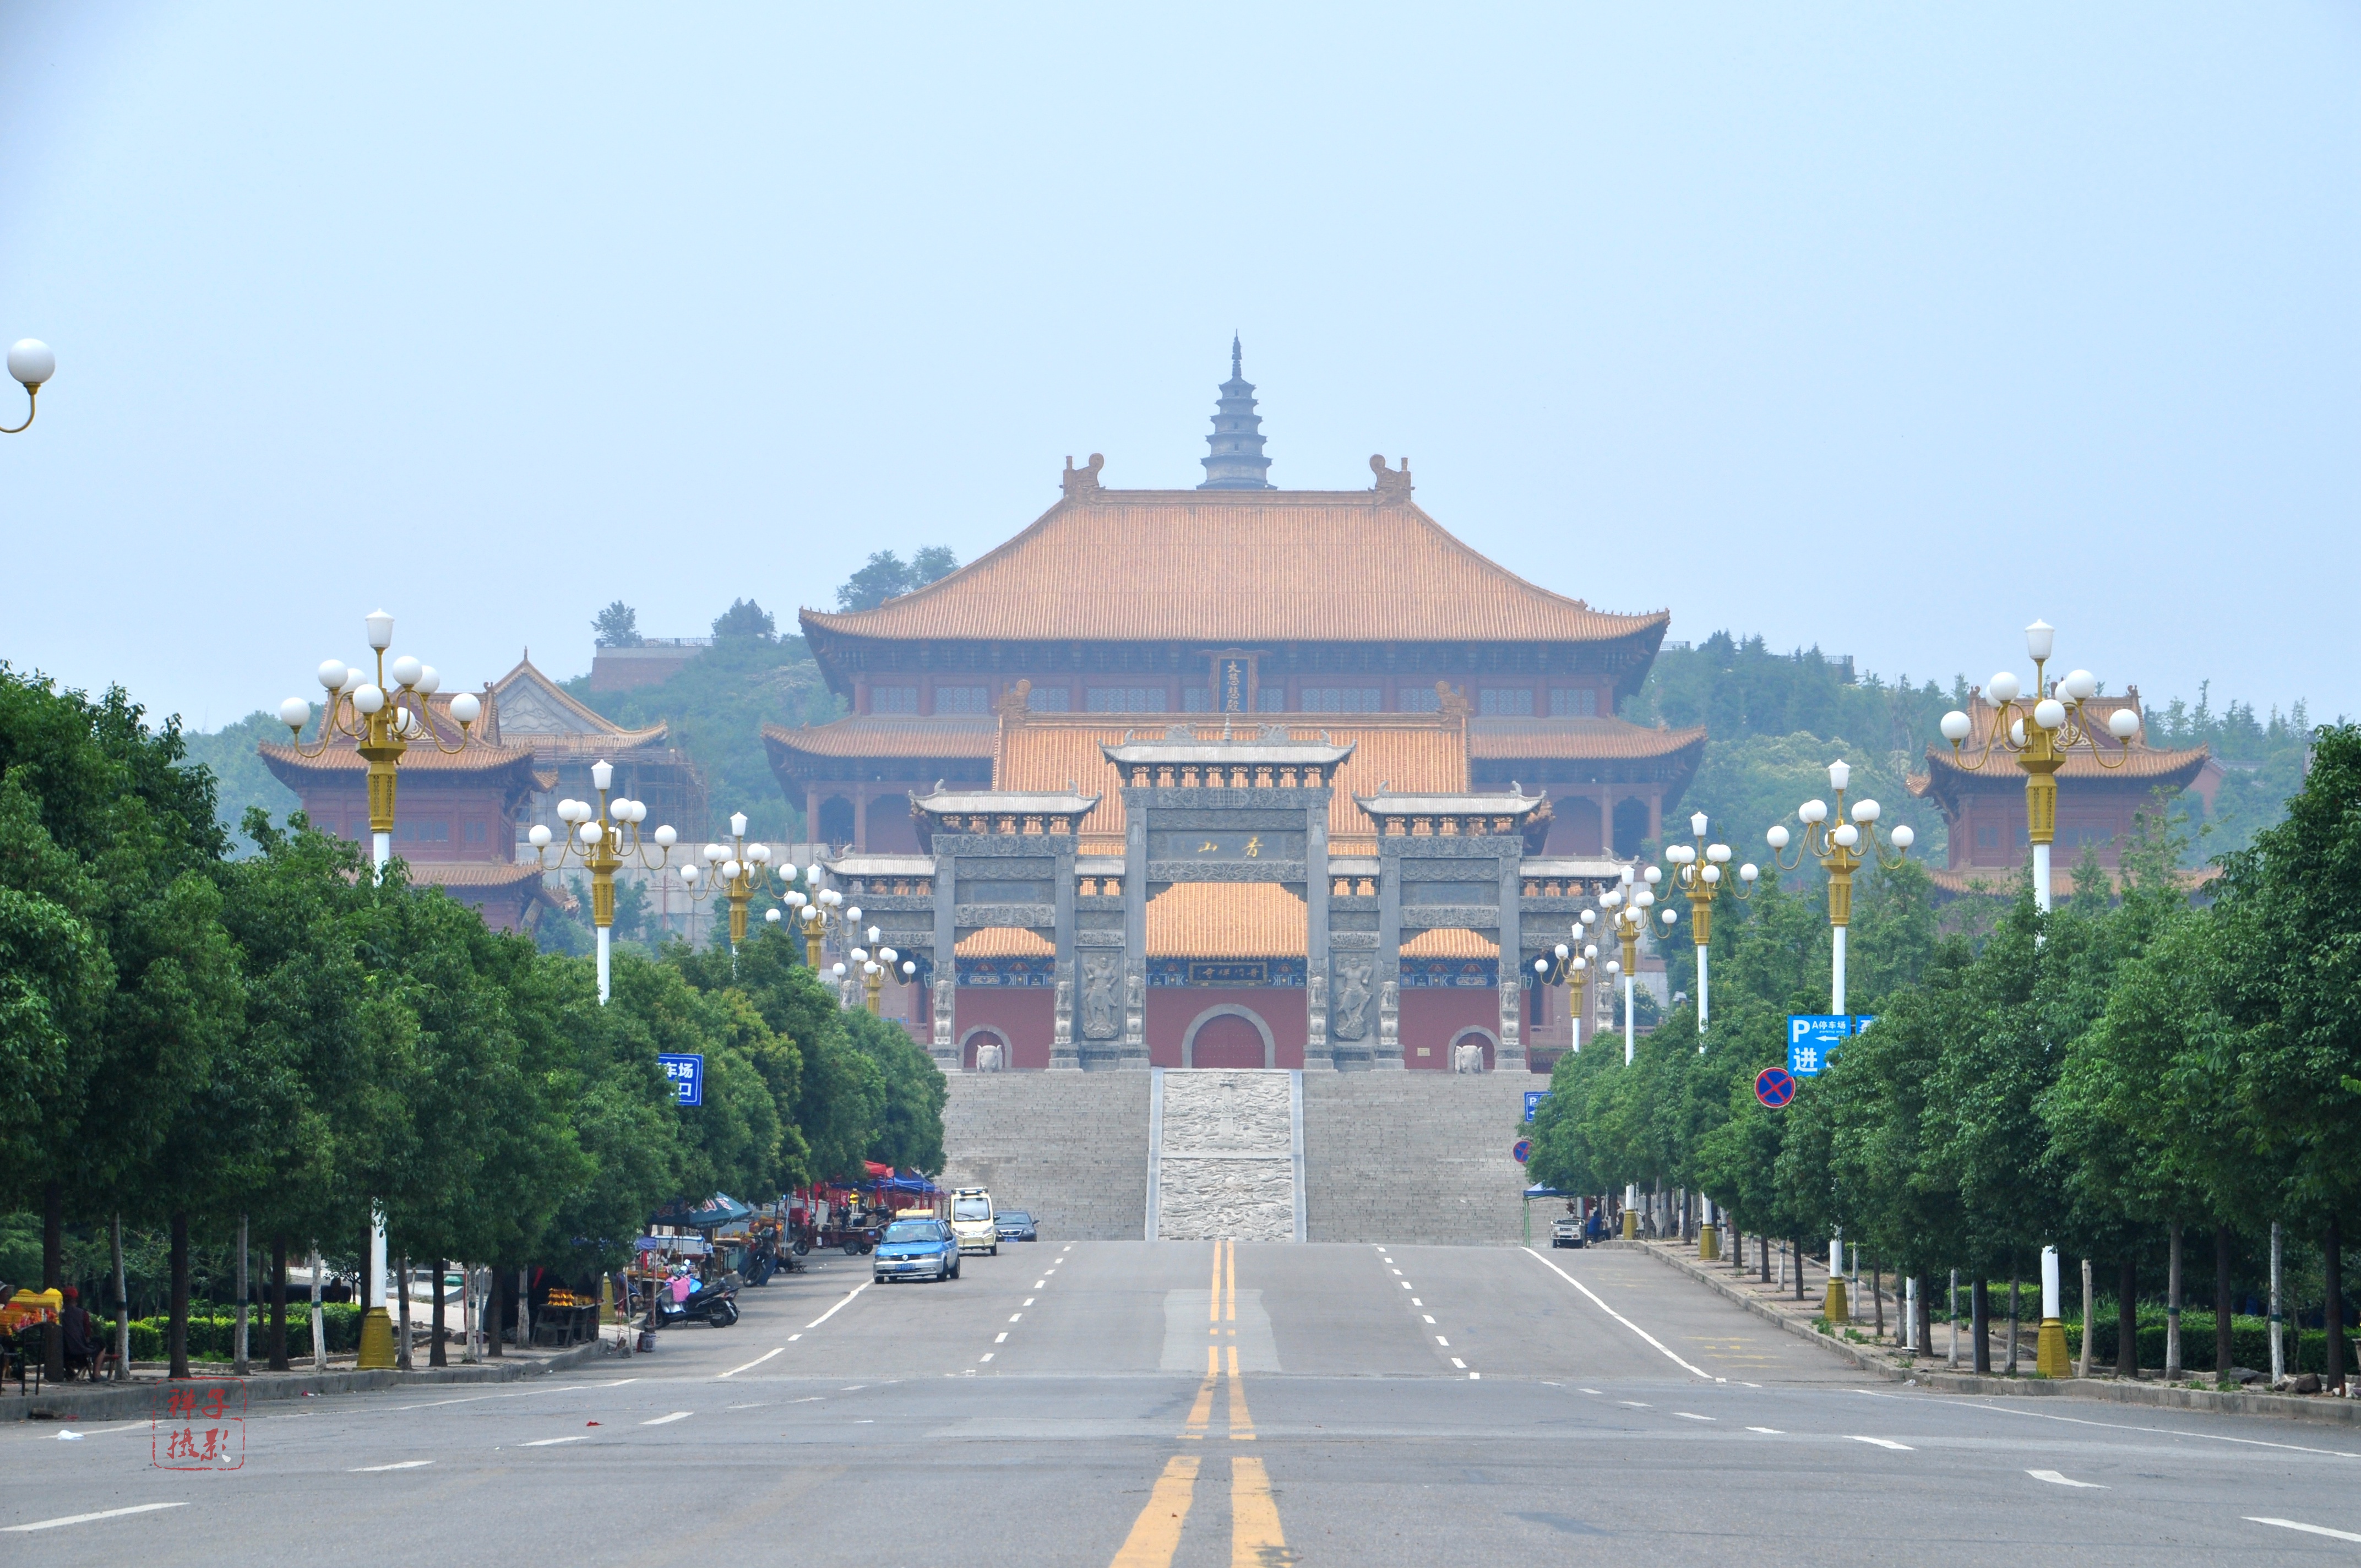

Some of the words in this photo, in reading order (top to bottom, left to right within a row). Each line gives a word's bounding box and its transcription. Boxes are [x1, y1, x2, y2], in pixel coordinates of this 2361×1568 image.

[1225, 661, 1242, 712] 大慈悲殿
[1793, 1020, 1810, 1042] P
[655, 1062, 693, 1079] 车场
[1530, 1097, 1537, 1106] P
